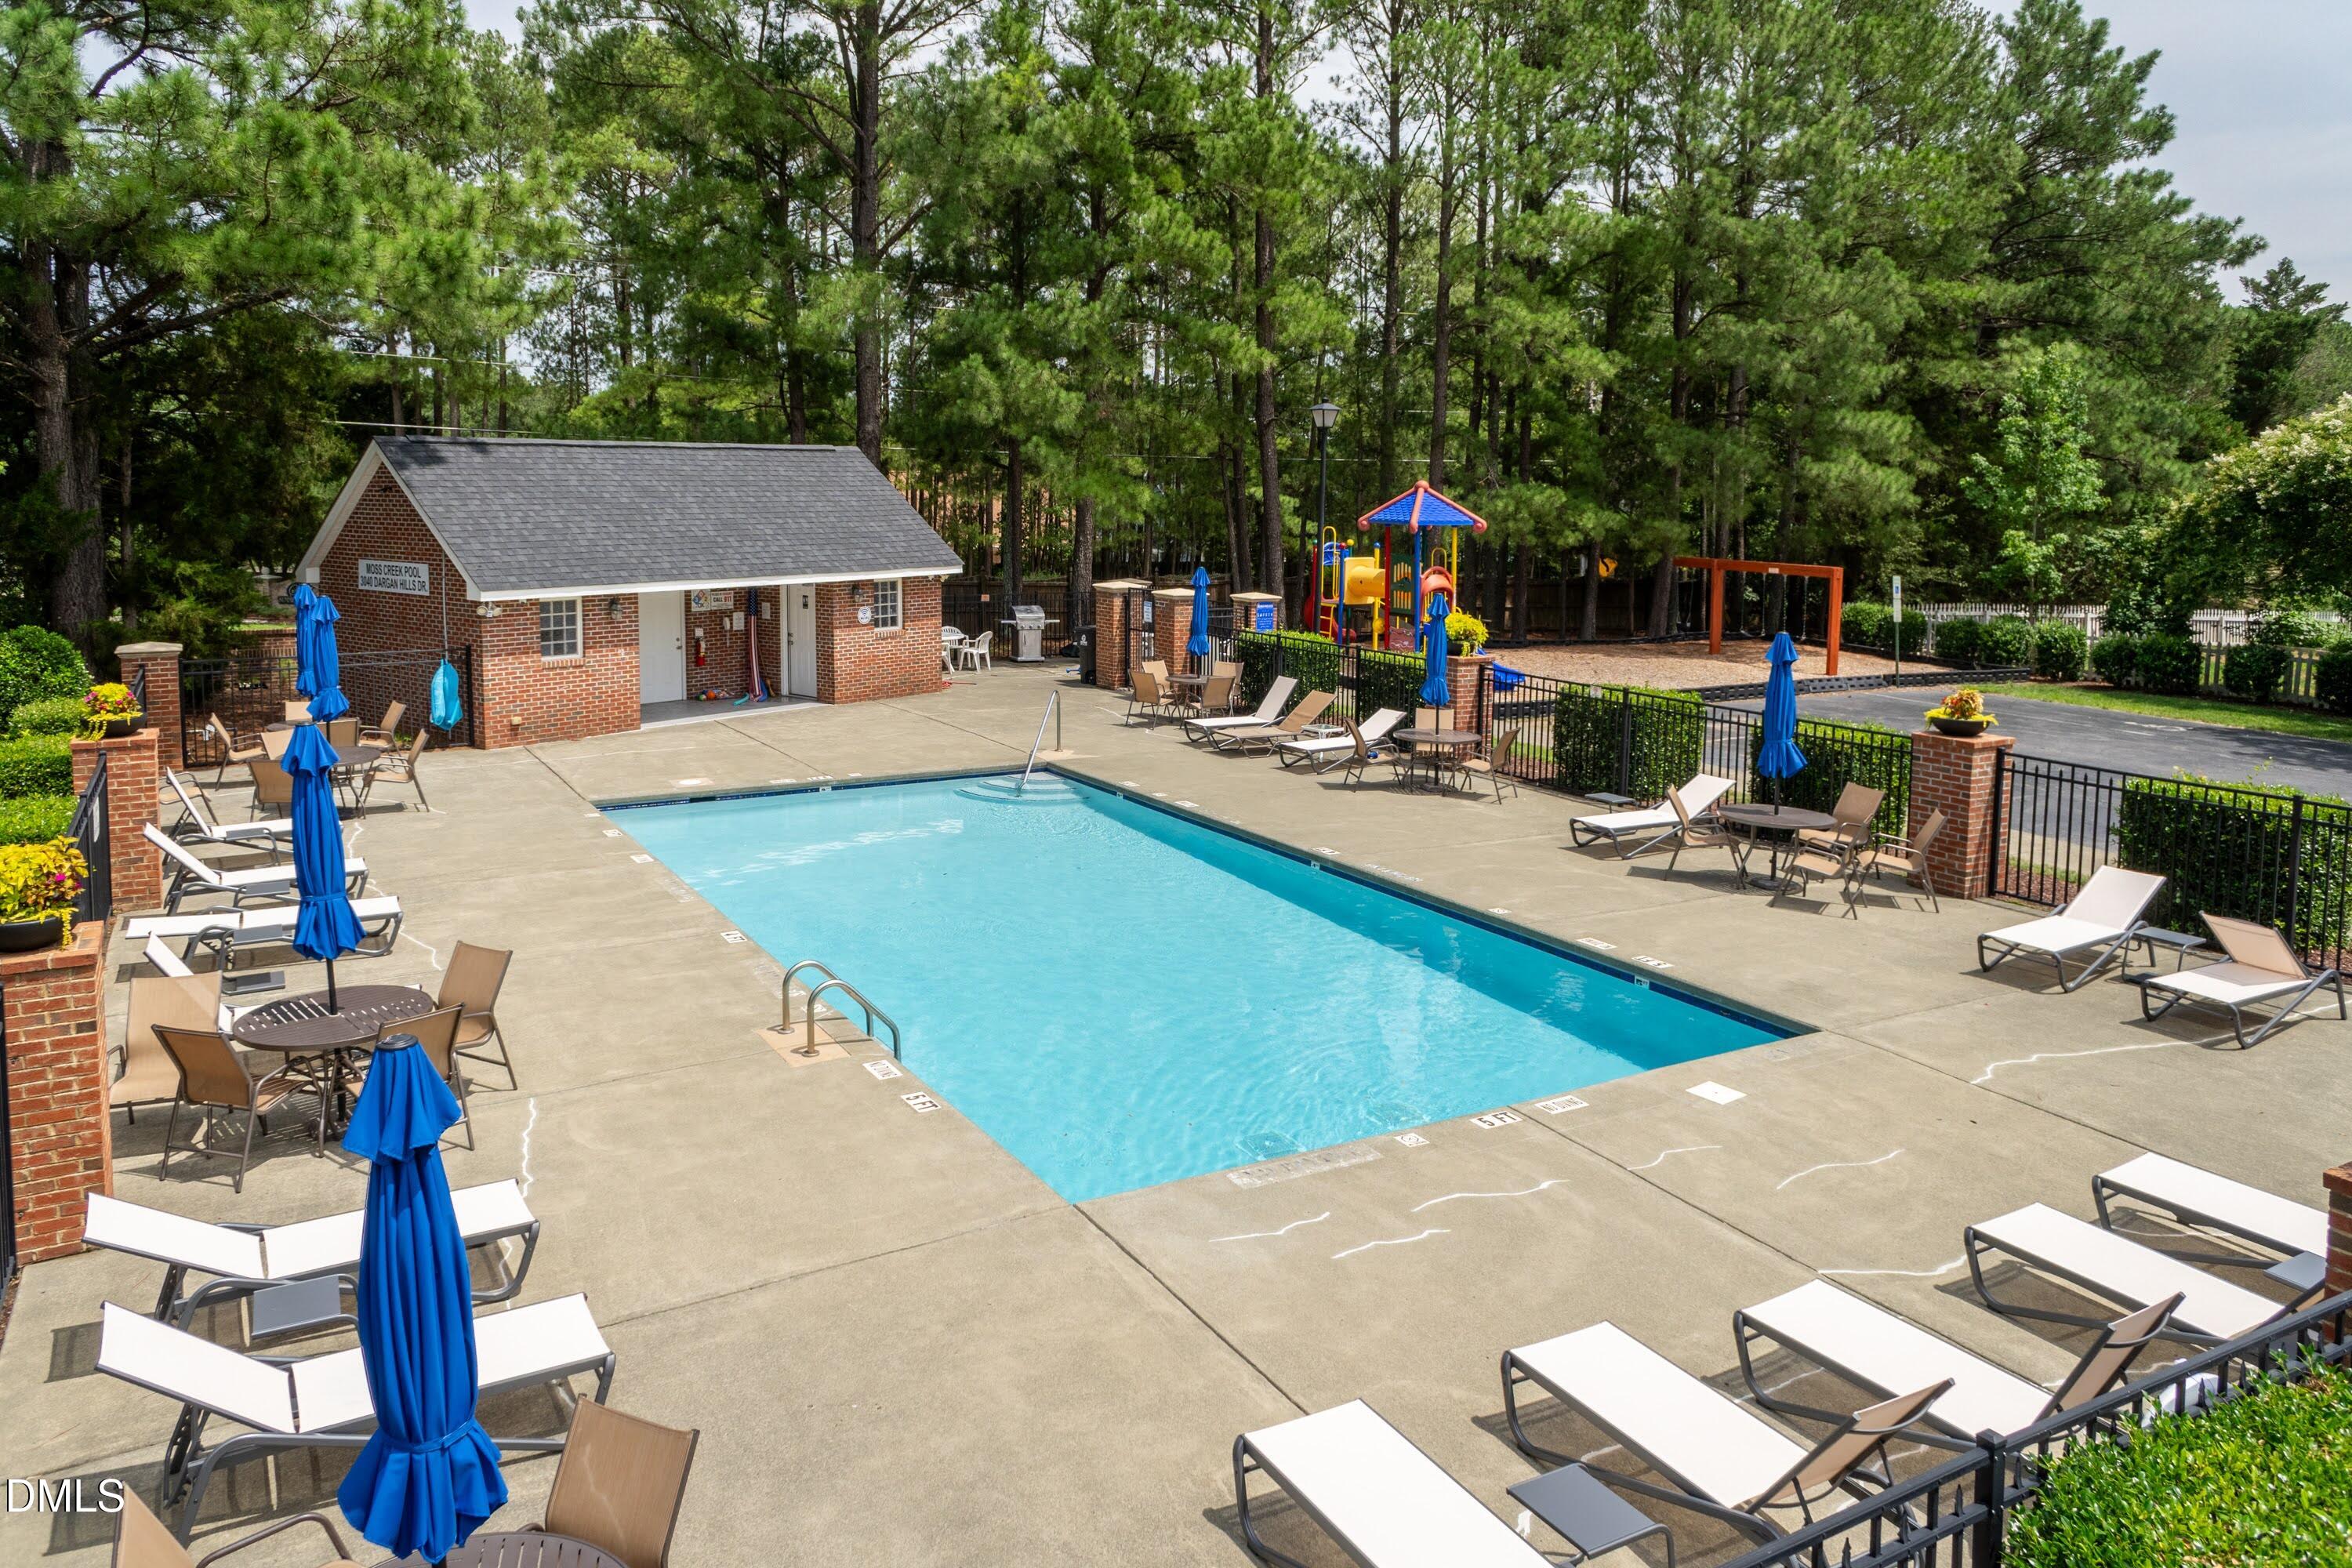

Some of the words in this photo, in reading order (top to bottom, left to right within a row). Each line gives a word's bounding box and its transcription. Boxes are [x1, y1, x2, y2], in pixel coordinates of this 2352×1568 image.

[366, 563, 383, 575] MOSS
[383, 564, 404, 577] CREEK
[405, 566, 422, 579] POOL
[360, 575, 373, 587] 3040
[374, 576, 398, 590] DARGAN
[400, 579, 416, 591] HILLS
[913, 1100, 938, 1110] FT
[1476, 1117, 1495, 1127] 5
[1491, 1112, 1517, 1123] FT
